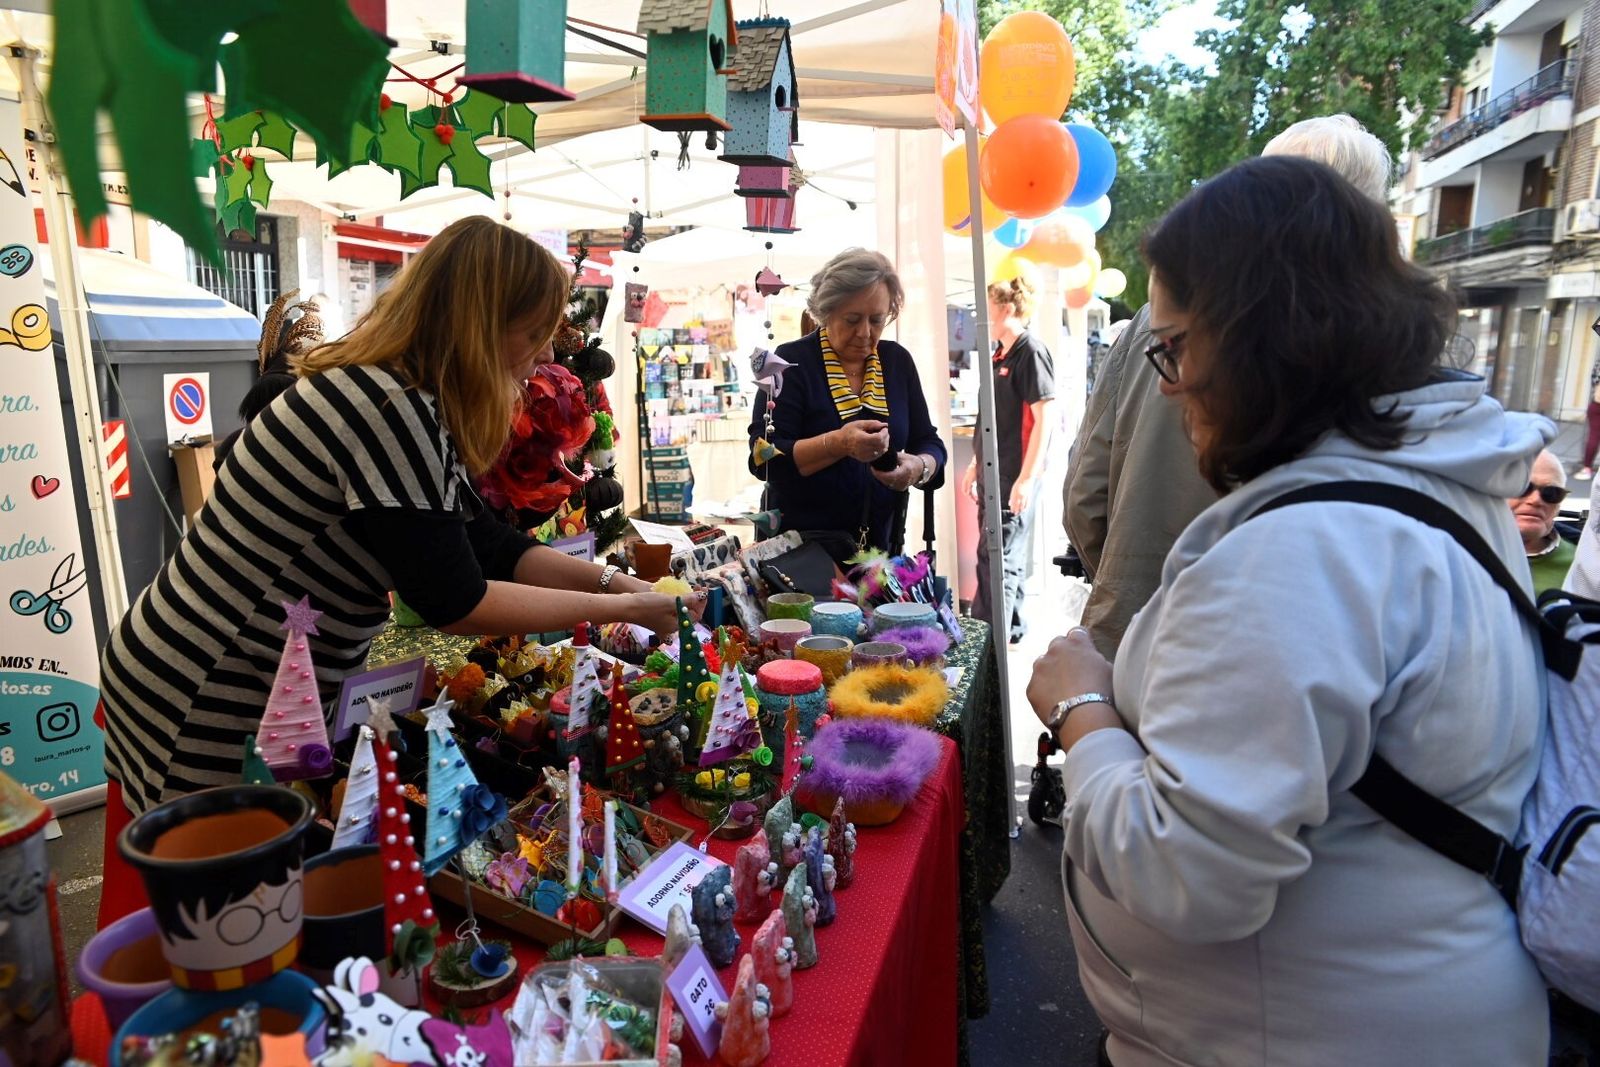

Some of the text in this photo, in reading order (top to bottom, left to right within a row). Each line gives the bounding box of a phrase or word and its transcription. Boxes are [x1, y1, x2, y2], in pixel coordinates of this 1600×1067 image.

[351, 682, 413, 707] ADONO NAVIDEÑO
[59, 769, 79, 787] 14
[646, 858, 700, 909] ADORNO NAVIDEÑO
[690, 977, 708, 1004] GATO
[704, 998, 715, 1016] 2€
